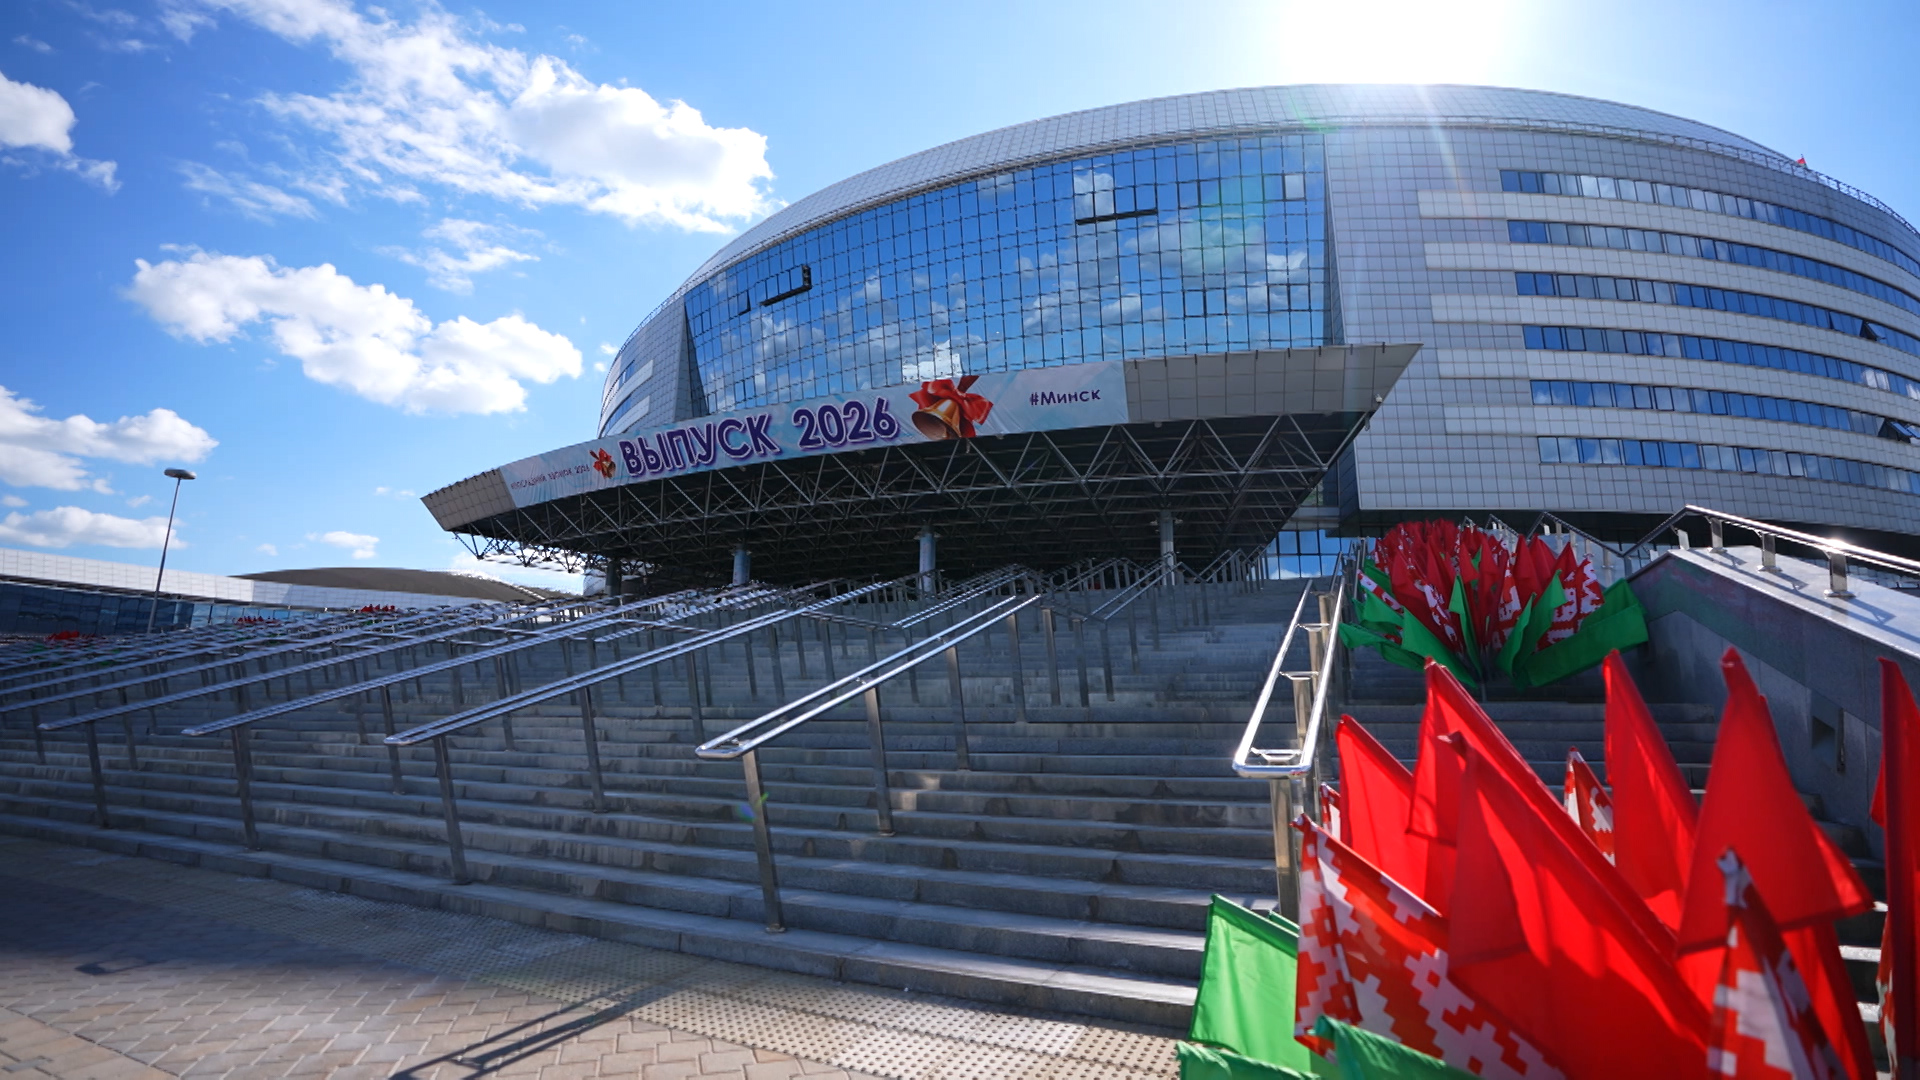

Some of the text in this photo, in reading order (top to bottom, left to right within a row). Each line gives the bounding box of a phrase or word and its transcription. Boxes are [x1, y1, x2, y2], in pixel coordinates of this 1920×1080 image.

[1029, 389, 1101, 406] #Минск
[619, 397, 898, 476] ВЫПУСК 2026
